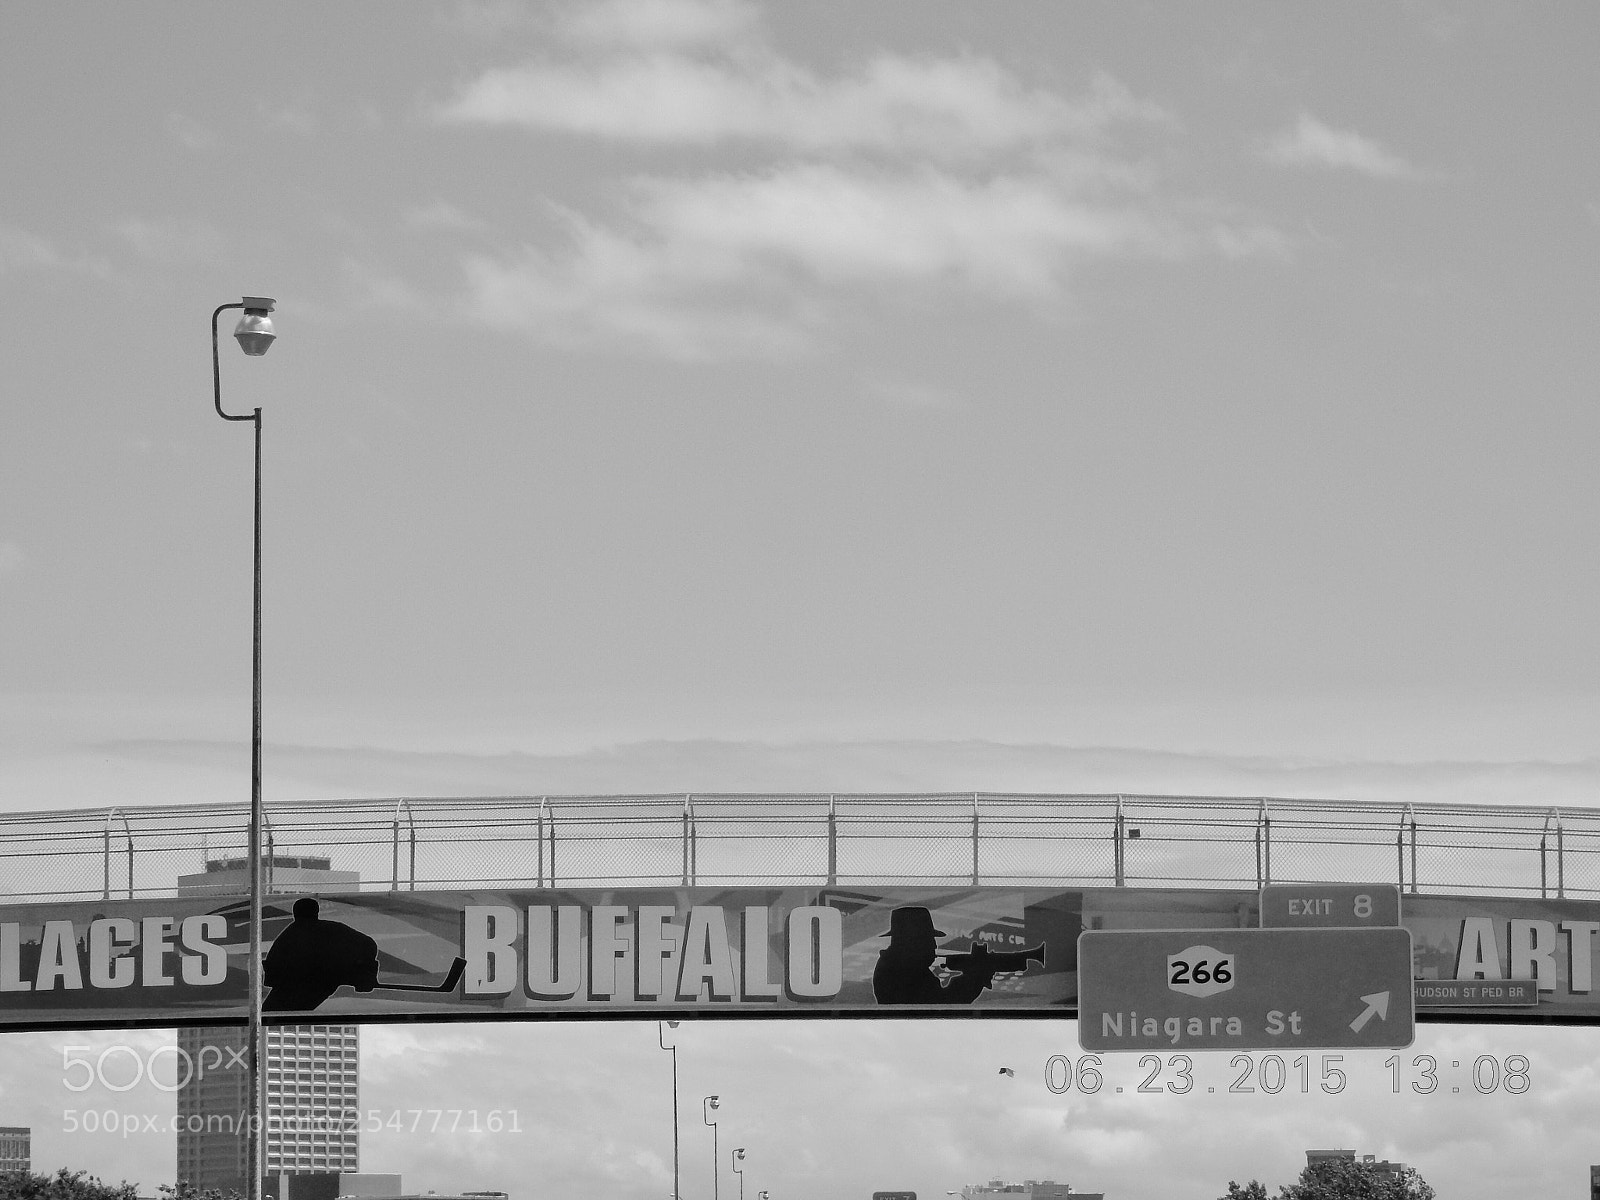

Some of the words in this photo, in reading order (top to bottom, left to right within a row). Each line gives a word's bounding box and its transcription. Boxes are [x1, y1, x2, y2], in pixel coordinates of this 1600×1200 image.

[1288, 899, 1333, 916] EXIT
[1352, 894, 1373, 918] 8
[0, 914, 228, 991] LACES
[462, 905, 843, 999] BUFFALO
[1455, 916, 1600, 993] ART
[1170, 960, 1232, 985] 266
[1463, 987, 1477, 998] ST
[1481, 987, 1503, 998] PED
[1508, 986, 1524, 997] BR
[1101, 1012, 1242, 1044] Niagara
[1265, 1010, 1302, 1036] St
